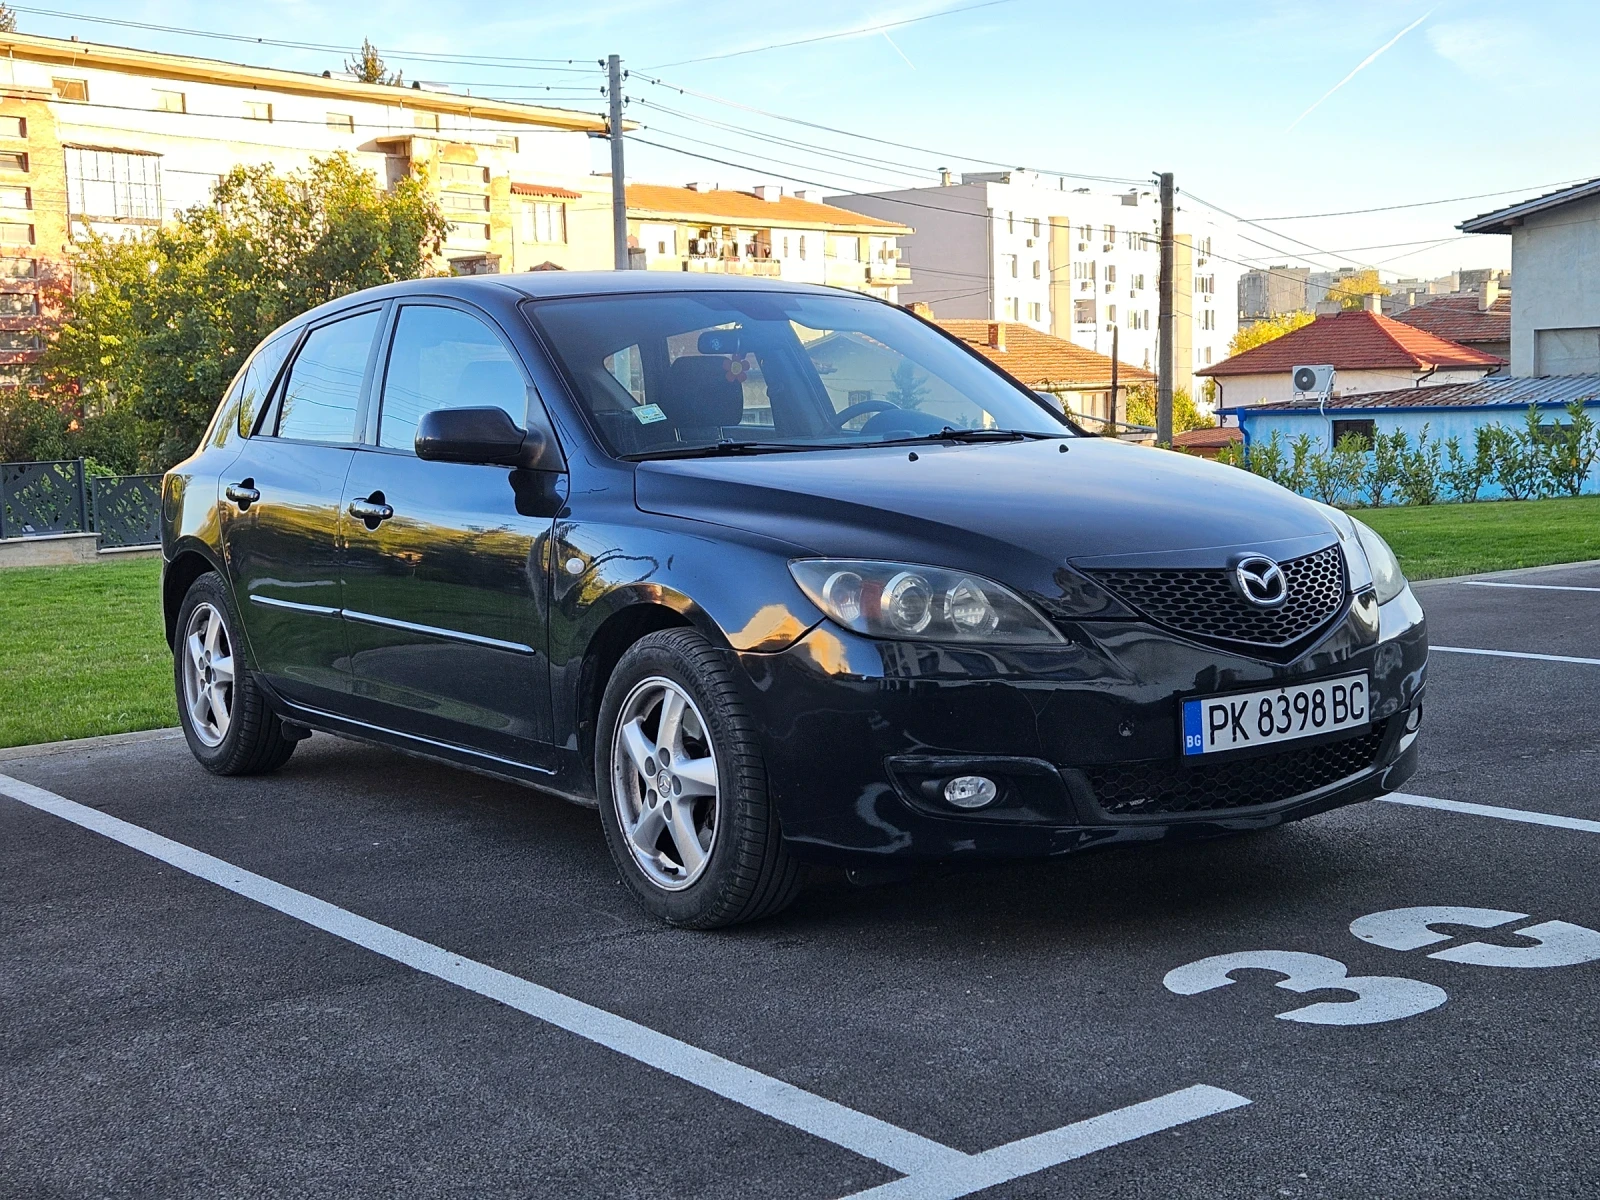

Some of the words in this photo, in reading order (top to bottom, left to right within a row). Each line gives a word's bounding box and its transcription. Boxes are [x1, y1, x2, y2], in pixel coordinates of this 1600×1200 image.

[1208, 700, 1250, 746] PK
[1257, 688, 1327, 737] 8398
[1332, 681, 1364, 725] BC
[1186, 734, 1202, 748] BG
